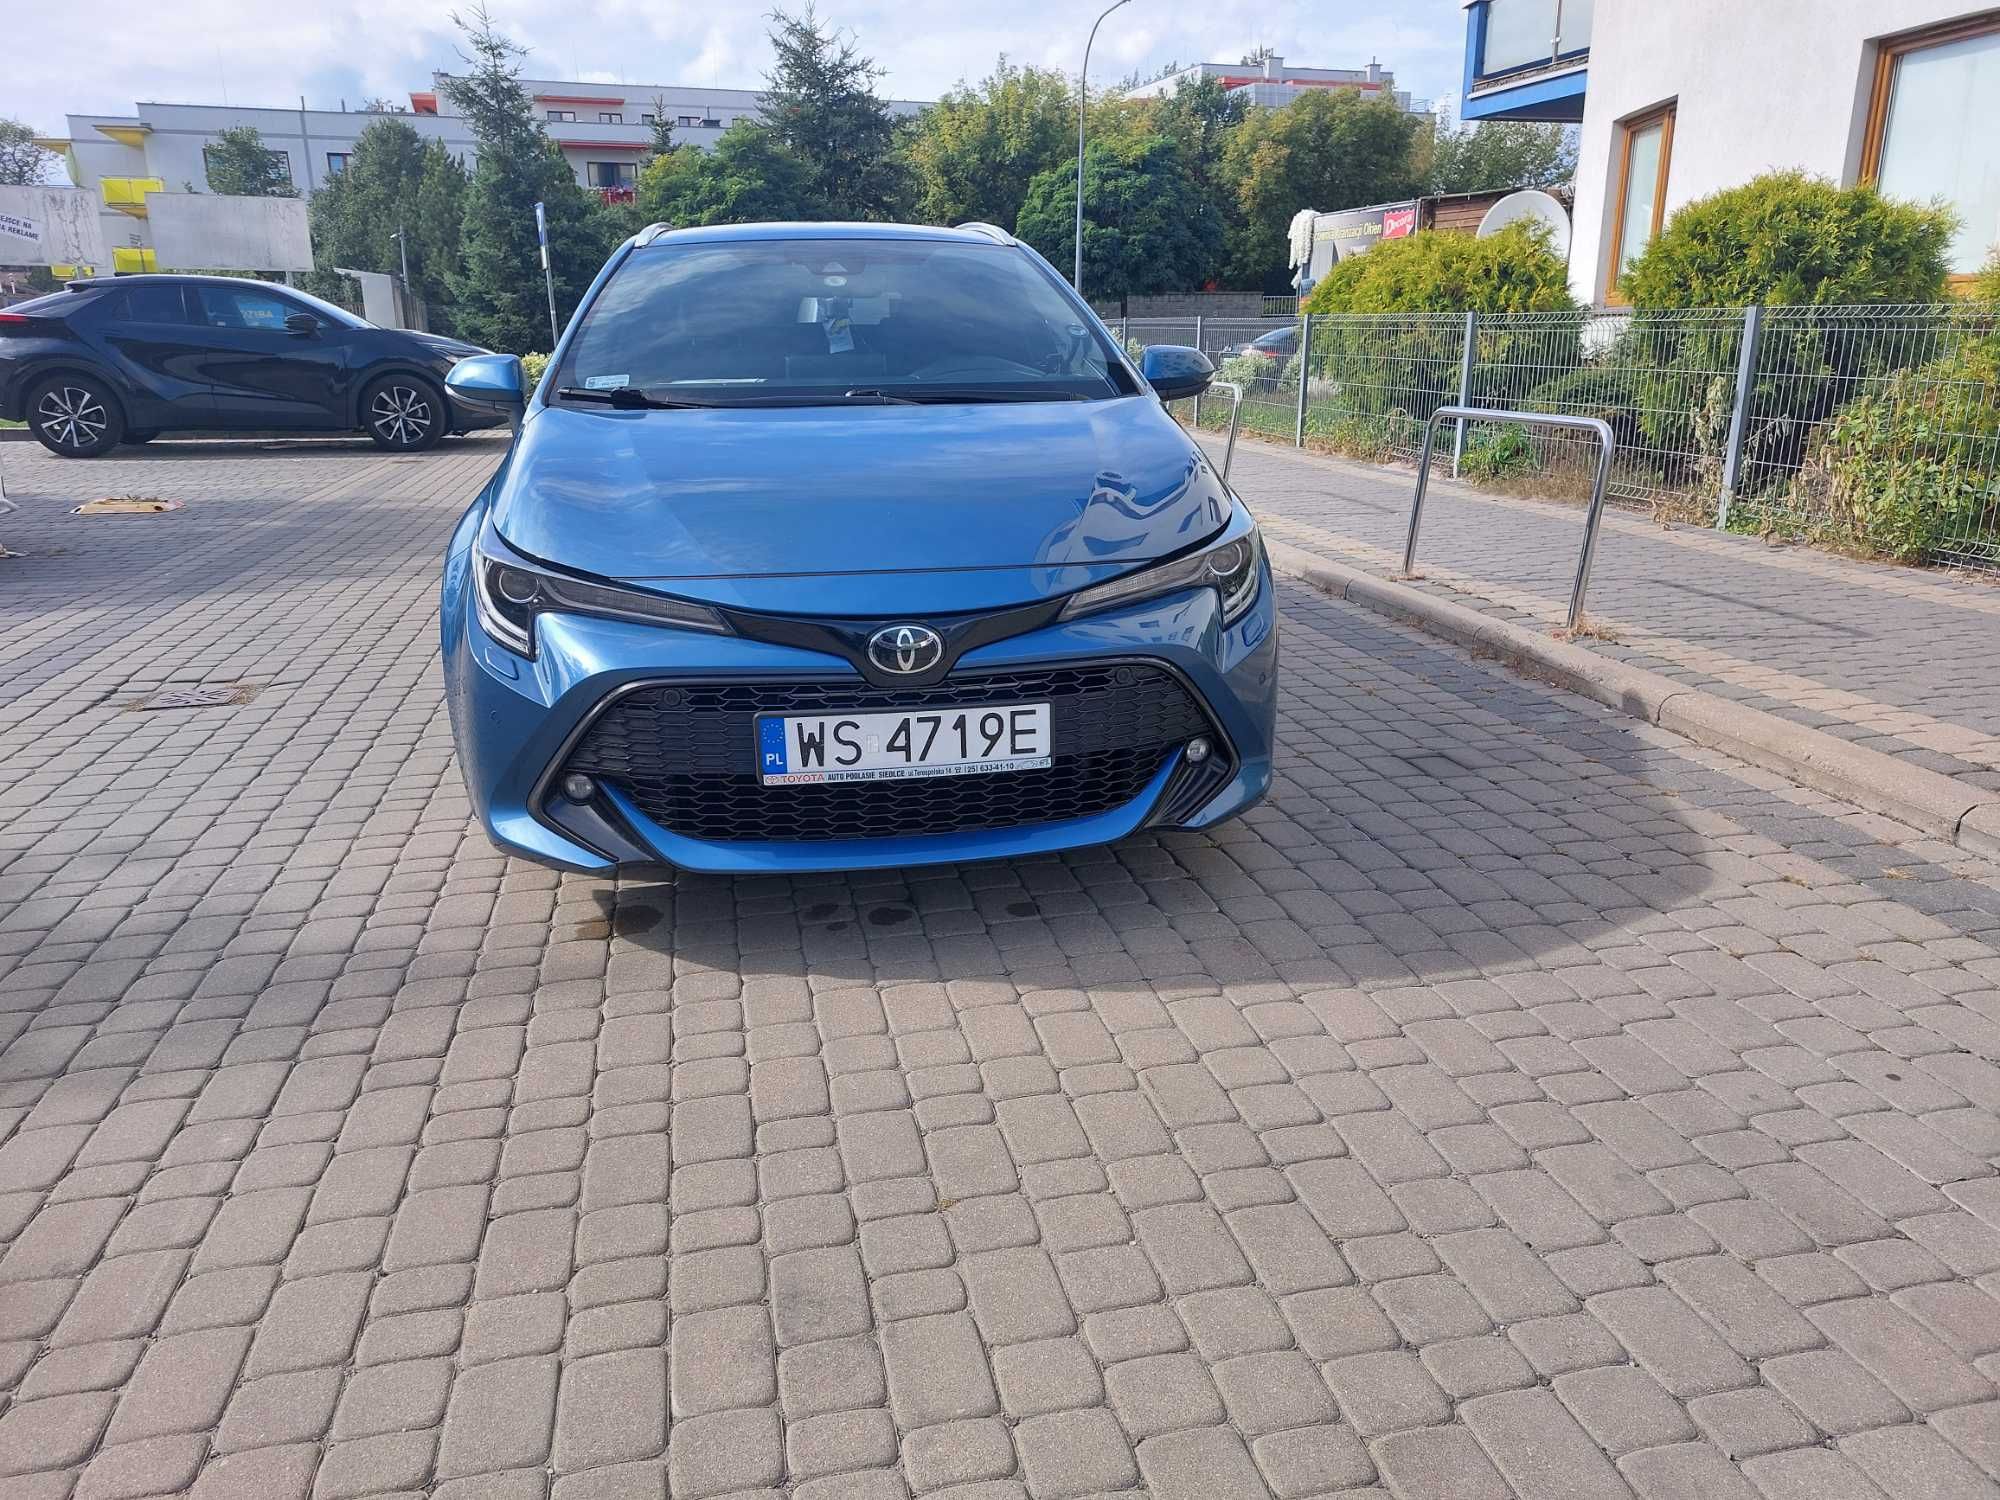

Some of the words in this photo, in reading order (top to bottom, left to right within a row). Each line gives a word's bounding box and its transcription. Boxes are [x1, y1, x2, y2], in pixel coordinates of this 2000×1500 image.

[797, 721, 862, 767] WS
[886, 709, 1037, 763] 4719E
[766, 753, 784, 767] PL
[783, 773, 825, 784] TOYOTA
[827, 773, 845, 781] AUTO
[845, 772, 876, 781] PODLASIE
[878, 769, 905, 779] SIEDLCE
